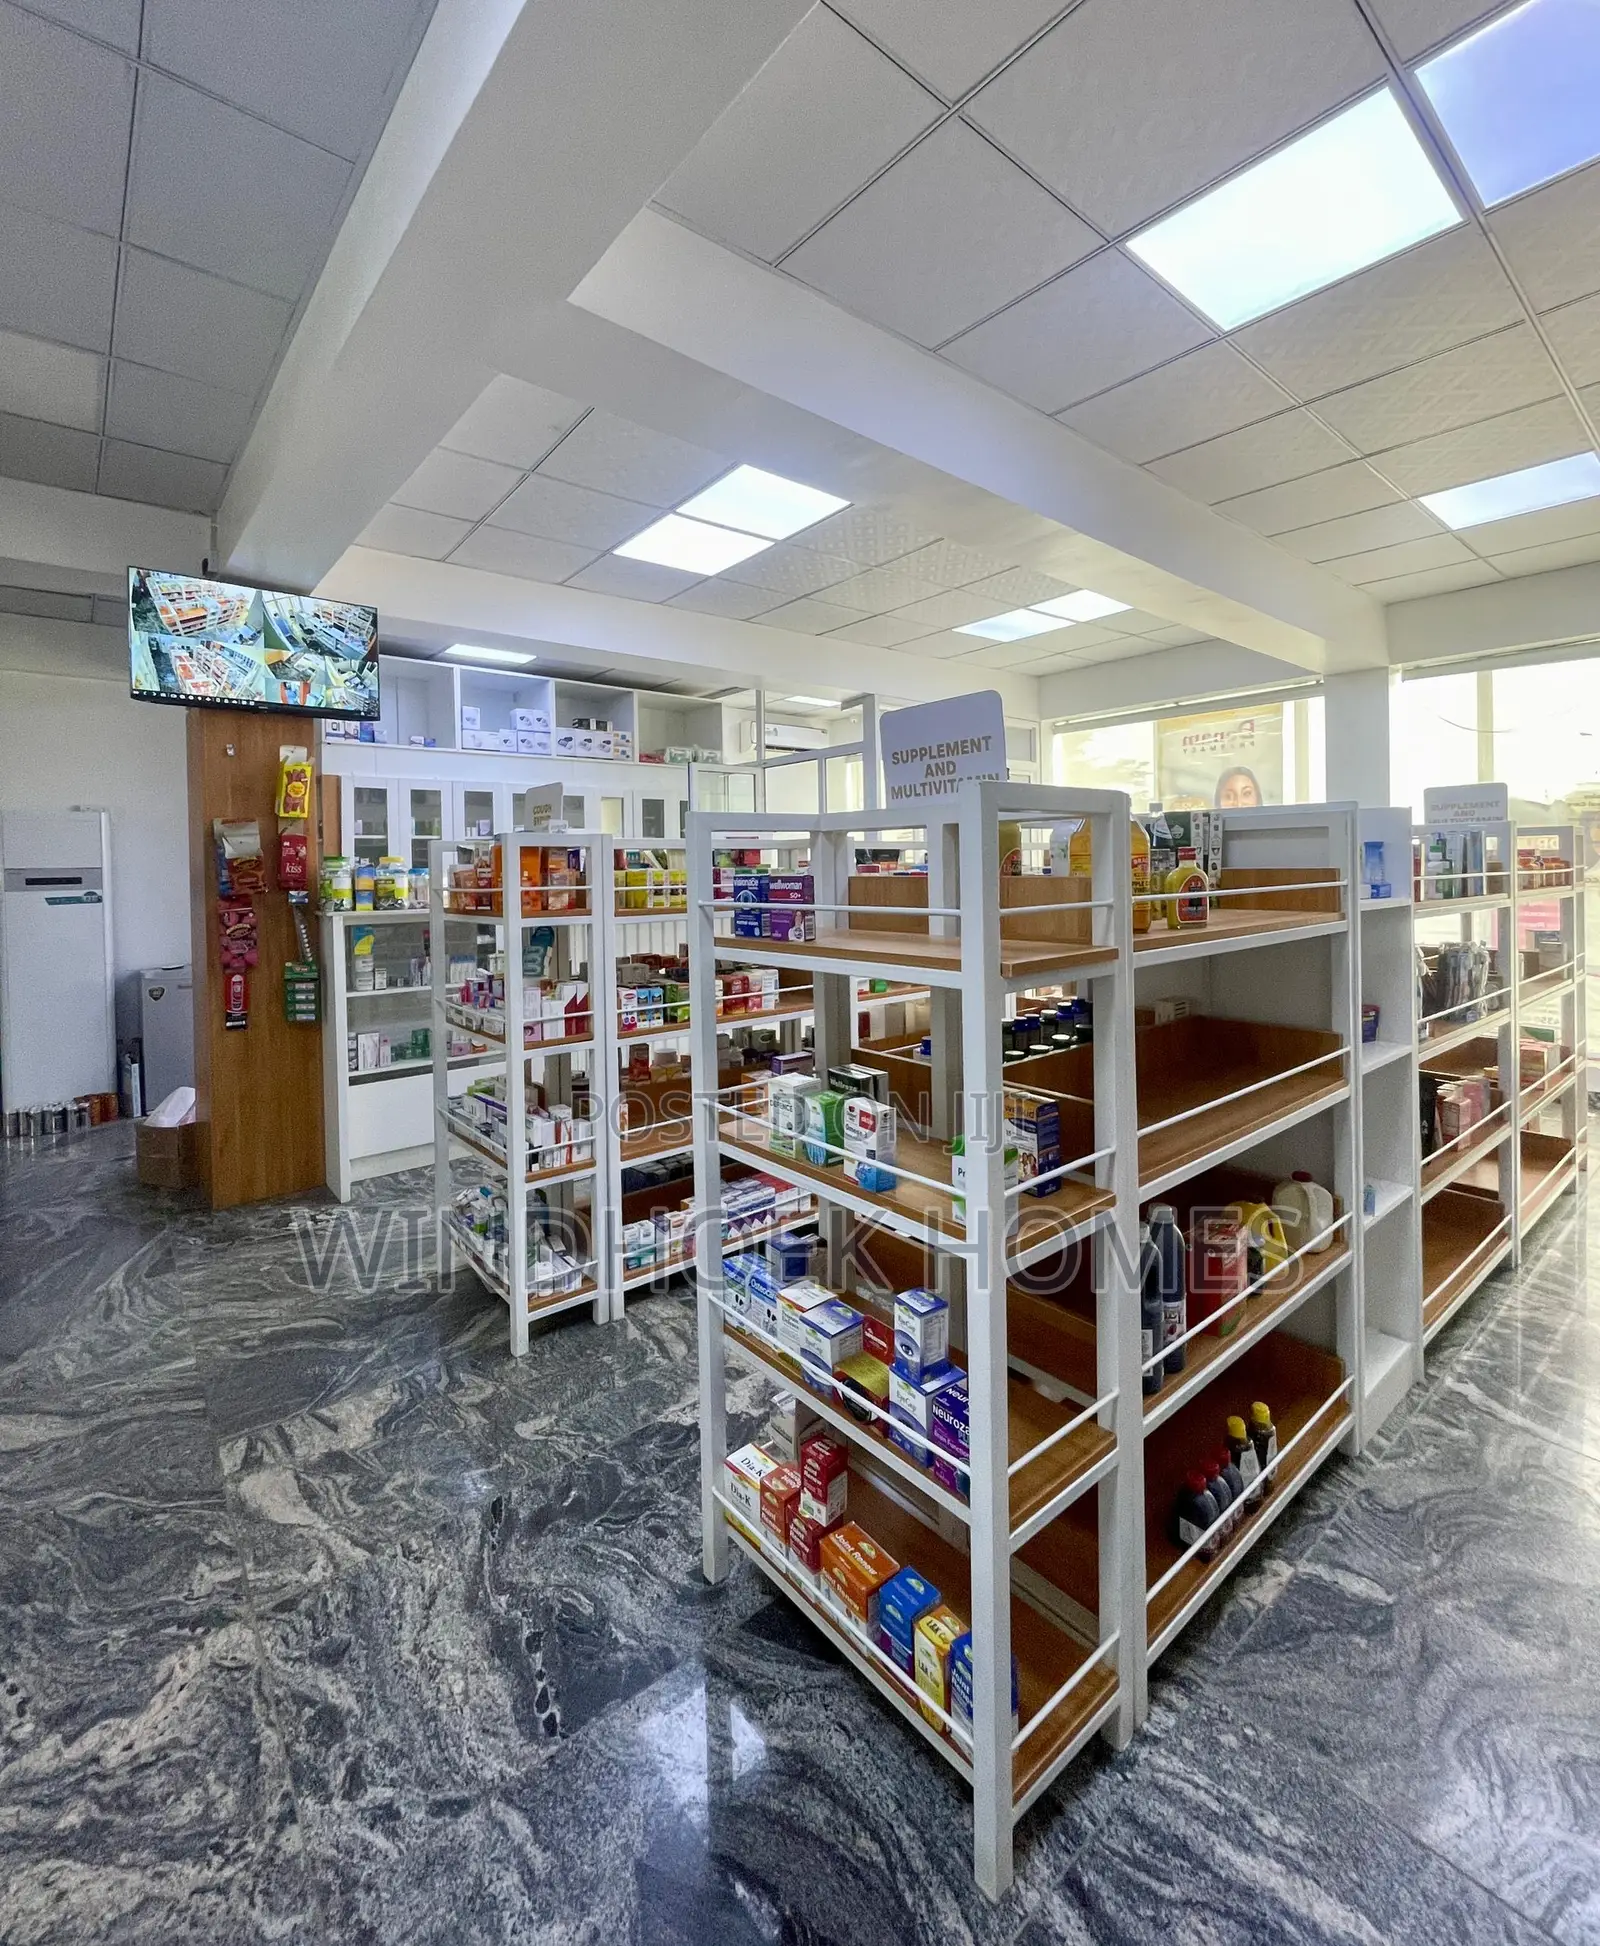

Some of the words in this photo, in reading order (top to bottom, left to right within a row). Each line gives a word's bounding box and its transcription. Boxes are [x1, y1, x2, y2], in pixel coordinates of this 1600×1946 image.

[892, 736, 991, 765] SUPPLEMENT
[925, 761, 956, 778] AND
[1431, 801, 1500, 811] SUPPLEMENT
[286, 863, 302, 873] kiss
[769, 880, 802, 890] wellwoman
[740, 1457, 765, 1477] Dia-K
[730, 1482, 752, 1507] Dia-K
[835, 1533, 855, 1553] Joint
[852, 1551, 878, 1575] Renew
